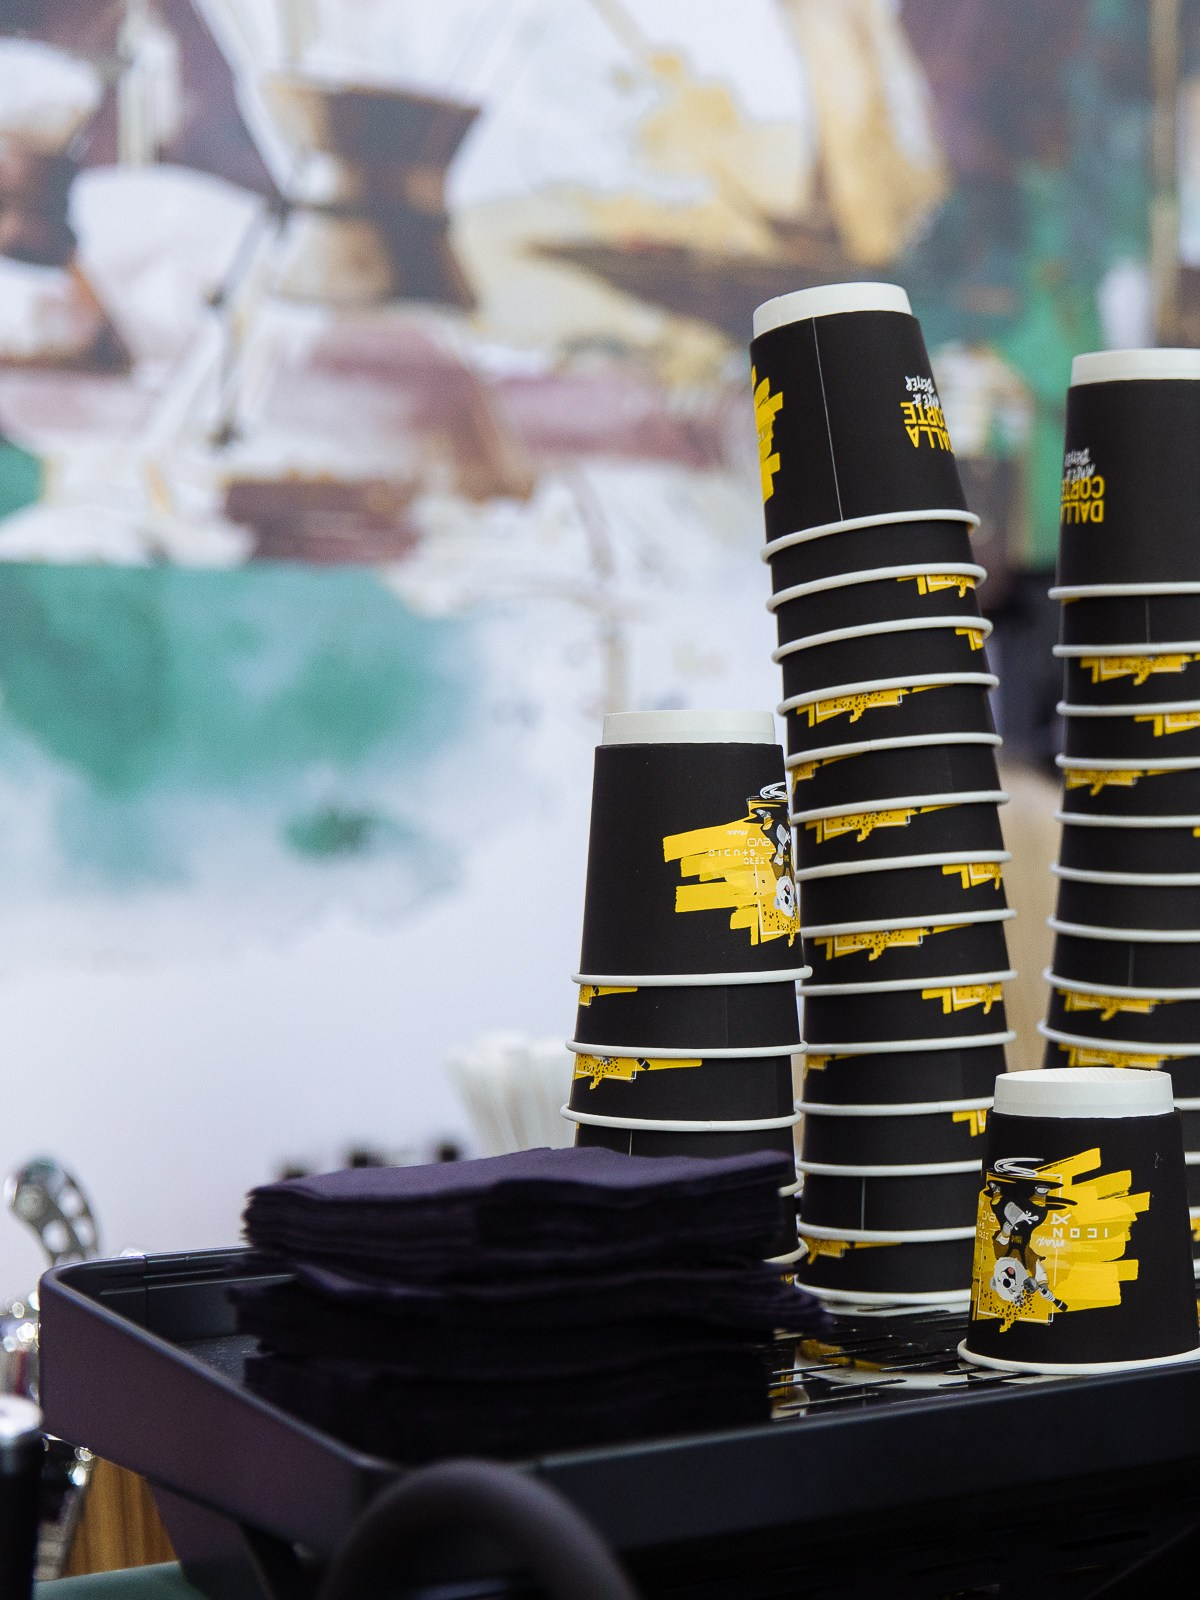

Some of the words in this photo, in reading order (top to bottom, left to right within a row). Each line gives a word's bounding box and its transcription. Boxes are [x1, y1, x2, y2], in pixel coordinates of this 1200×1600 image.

[900, 402, 946, 428] ORTE
[905, 425, 953, 453] ALLA
[1051, 1226, 1109, 1239] ICON
